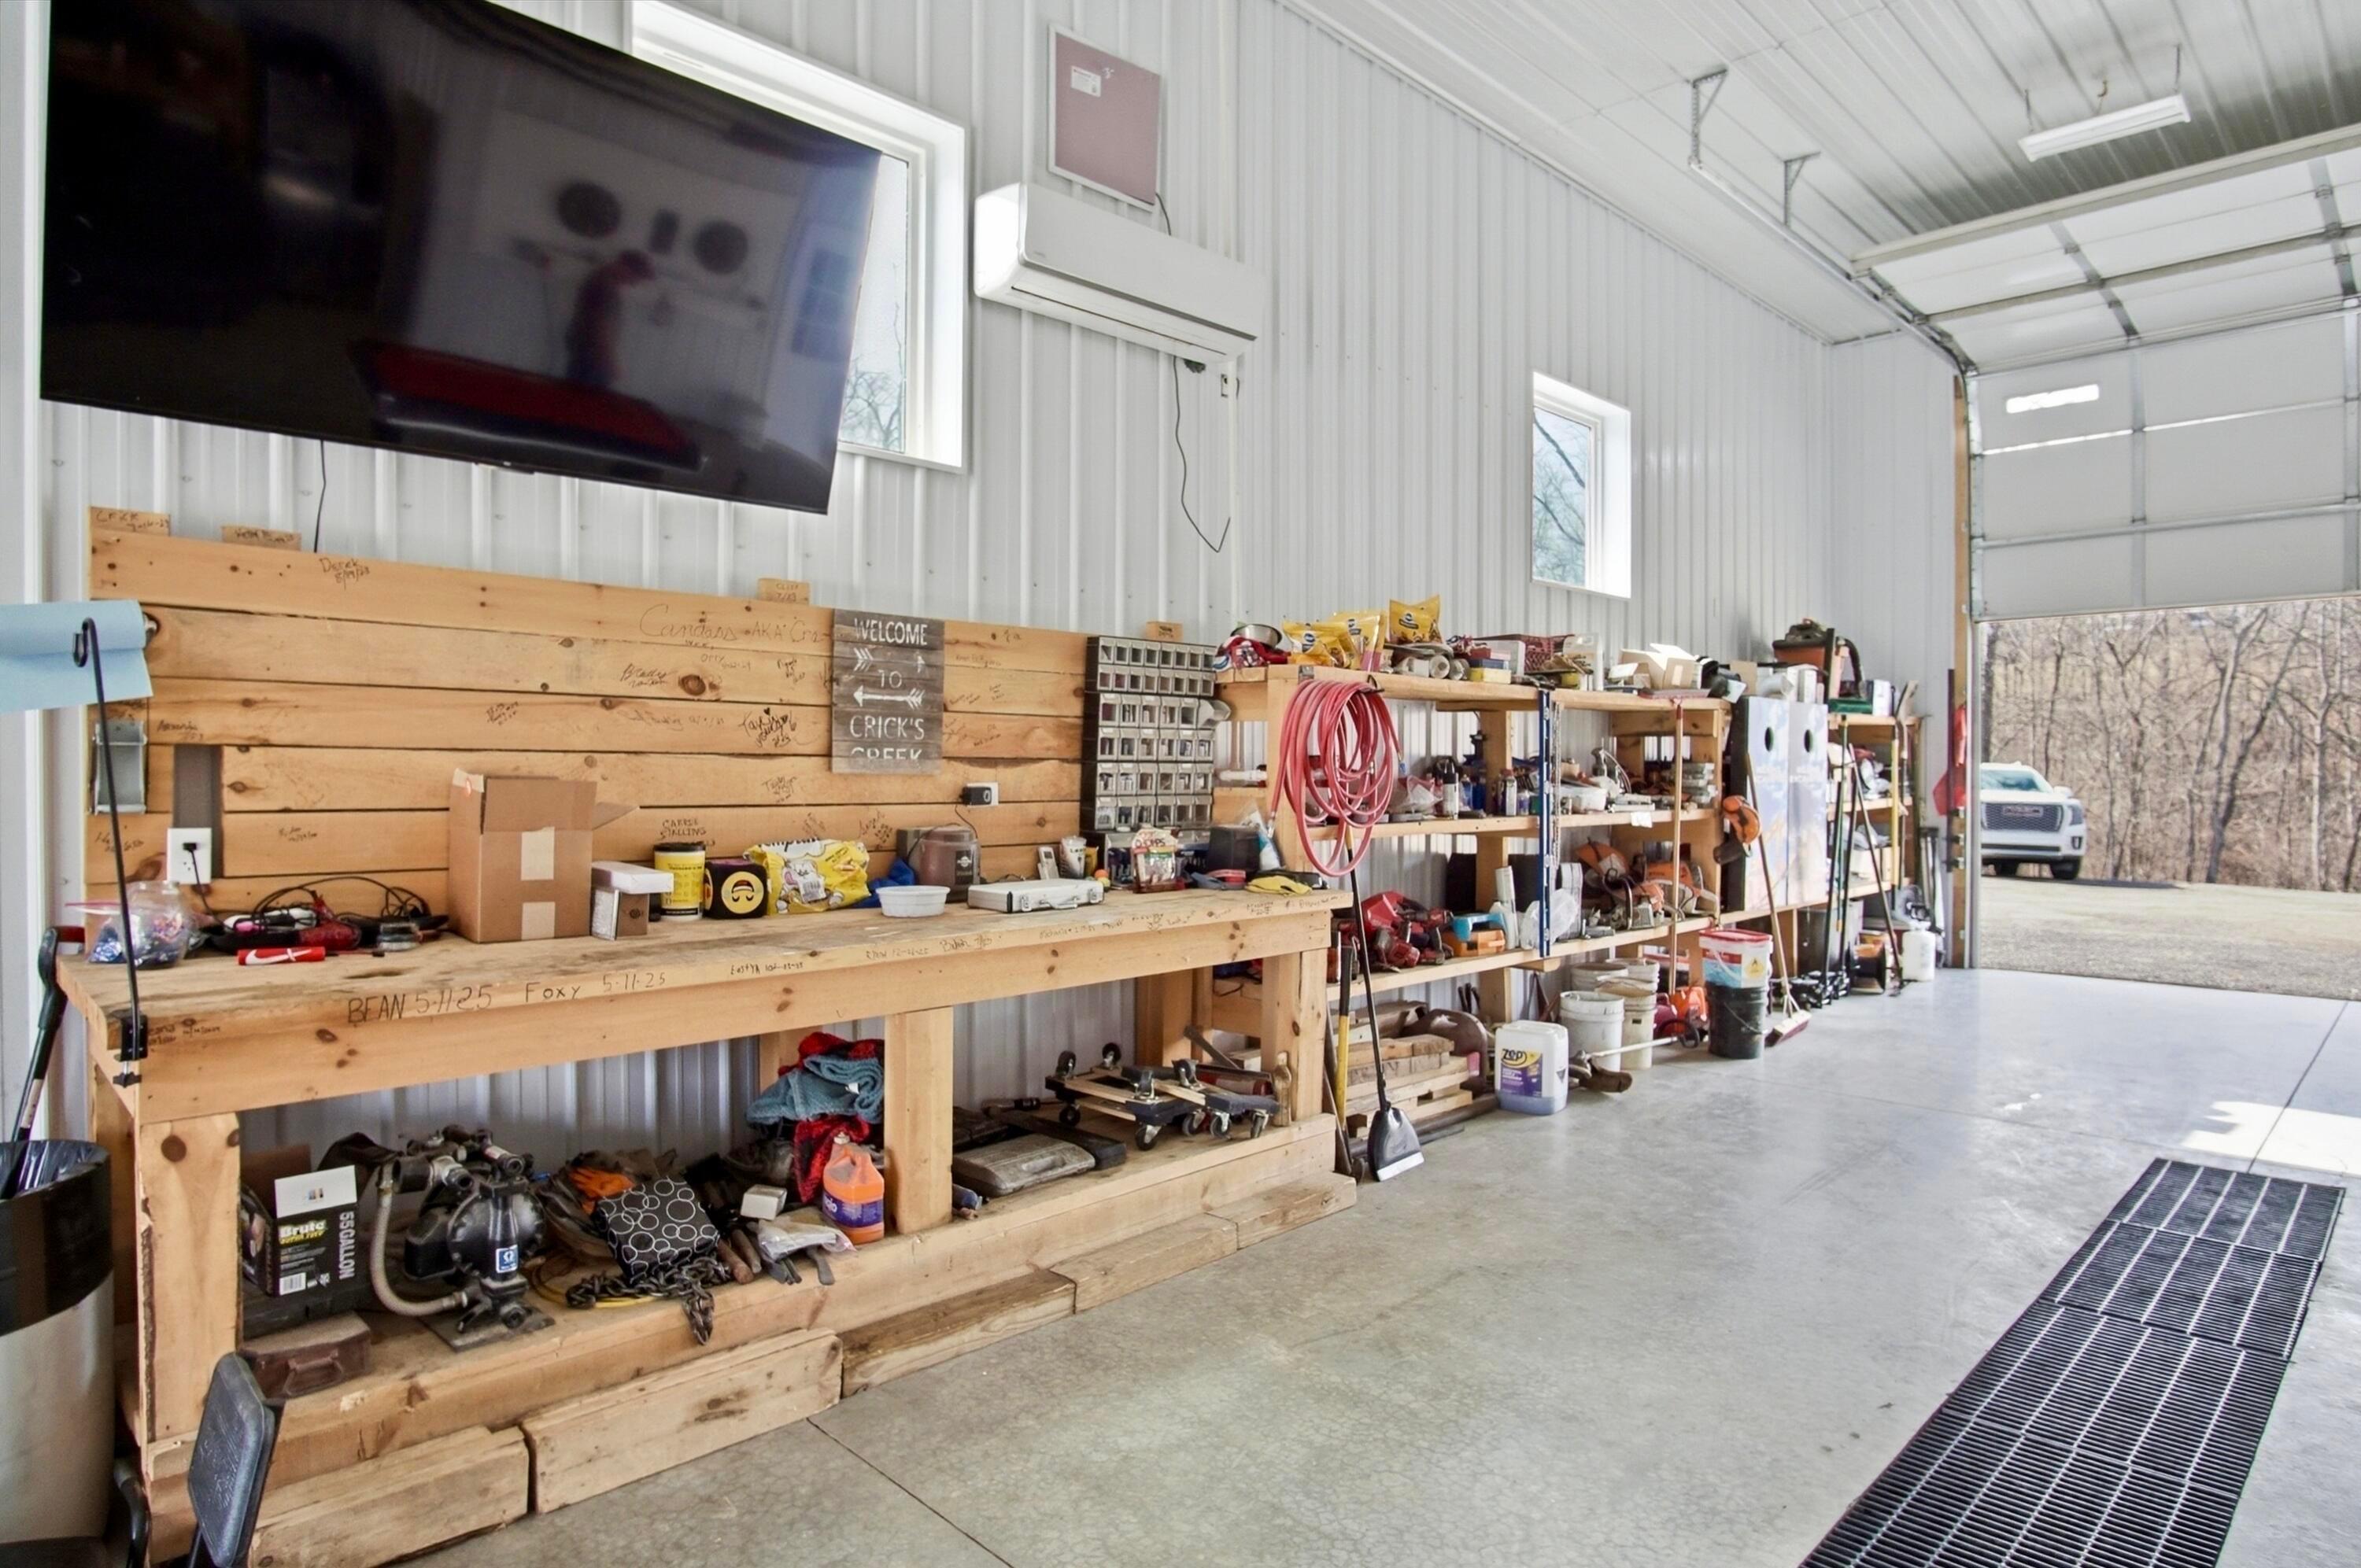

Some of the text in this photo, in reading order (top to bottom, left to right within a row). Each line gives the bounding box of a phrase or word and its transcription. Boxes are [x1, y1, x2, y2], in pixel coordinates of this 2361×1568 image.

[854, 618, 928, 646] WELCOME
[878, 670, 903, 688] TO
[849, 714, 925, 740] CRICK'S
[525, 982, 581, 1003] Foxy
[348, 993, 406, 1024] BEAN
[279, 1219, 327, 1238] Brute
